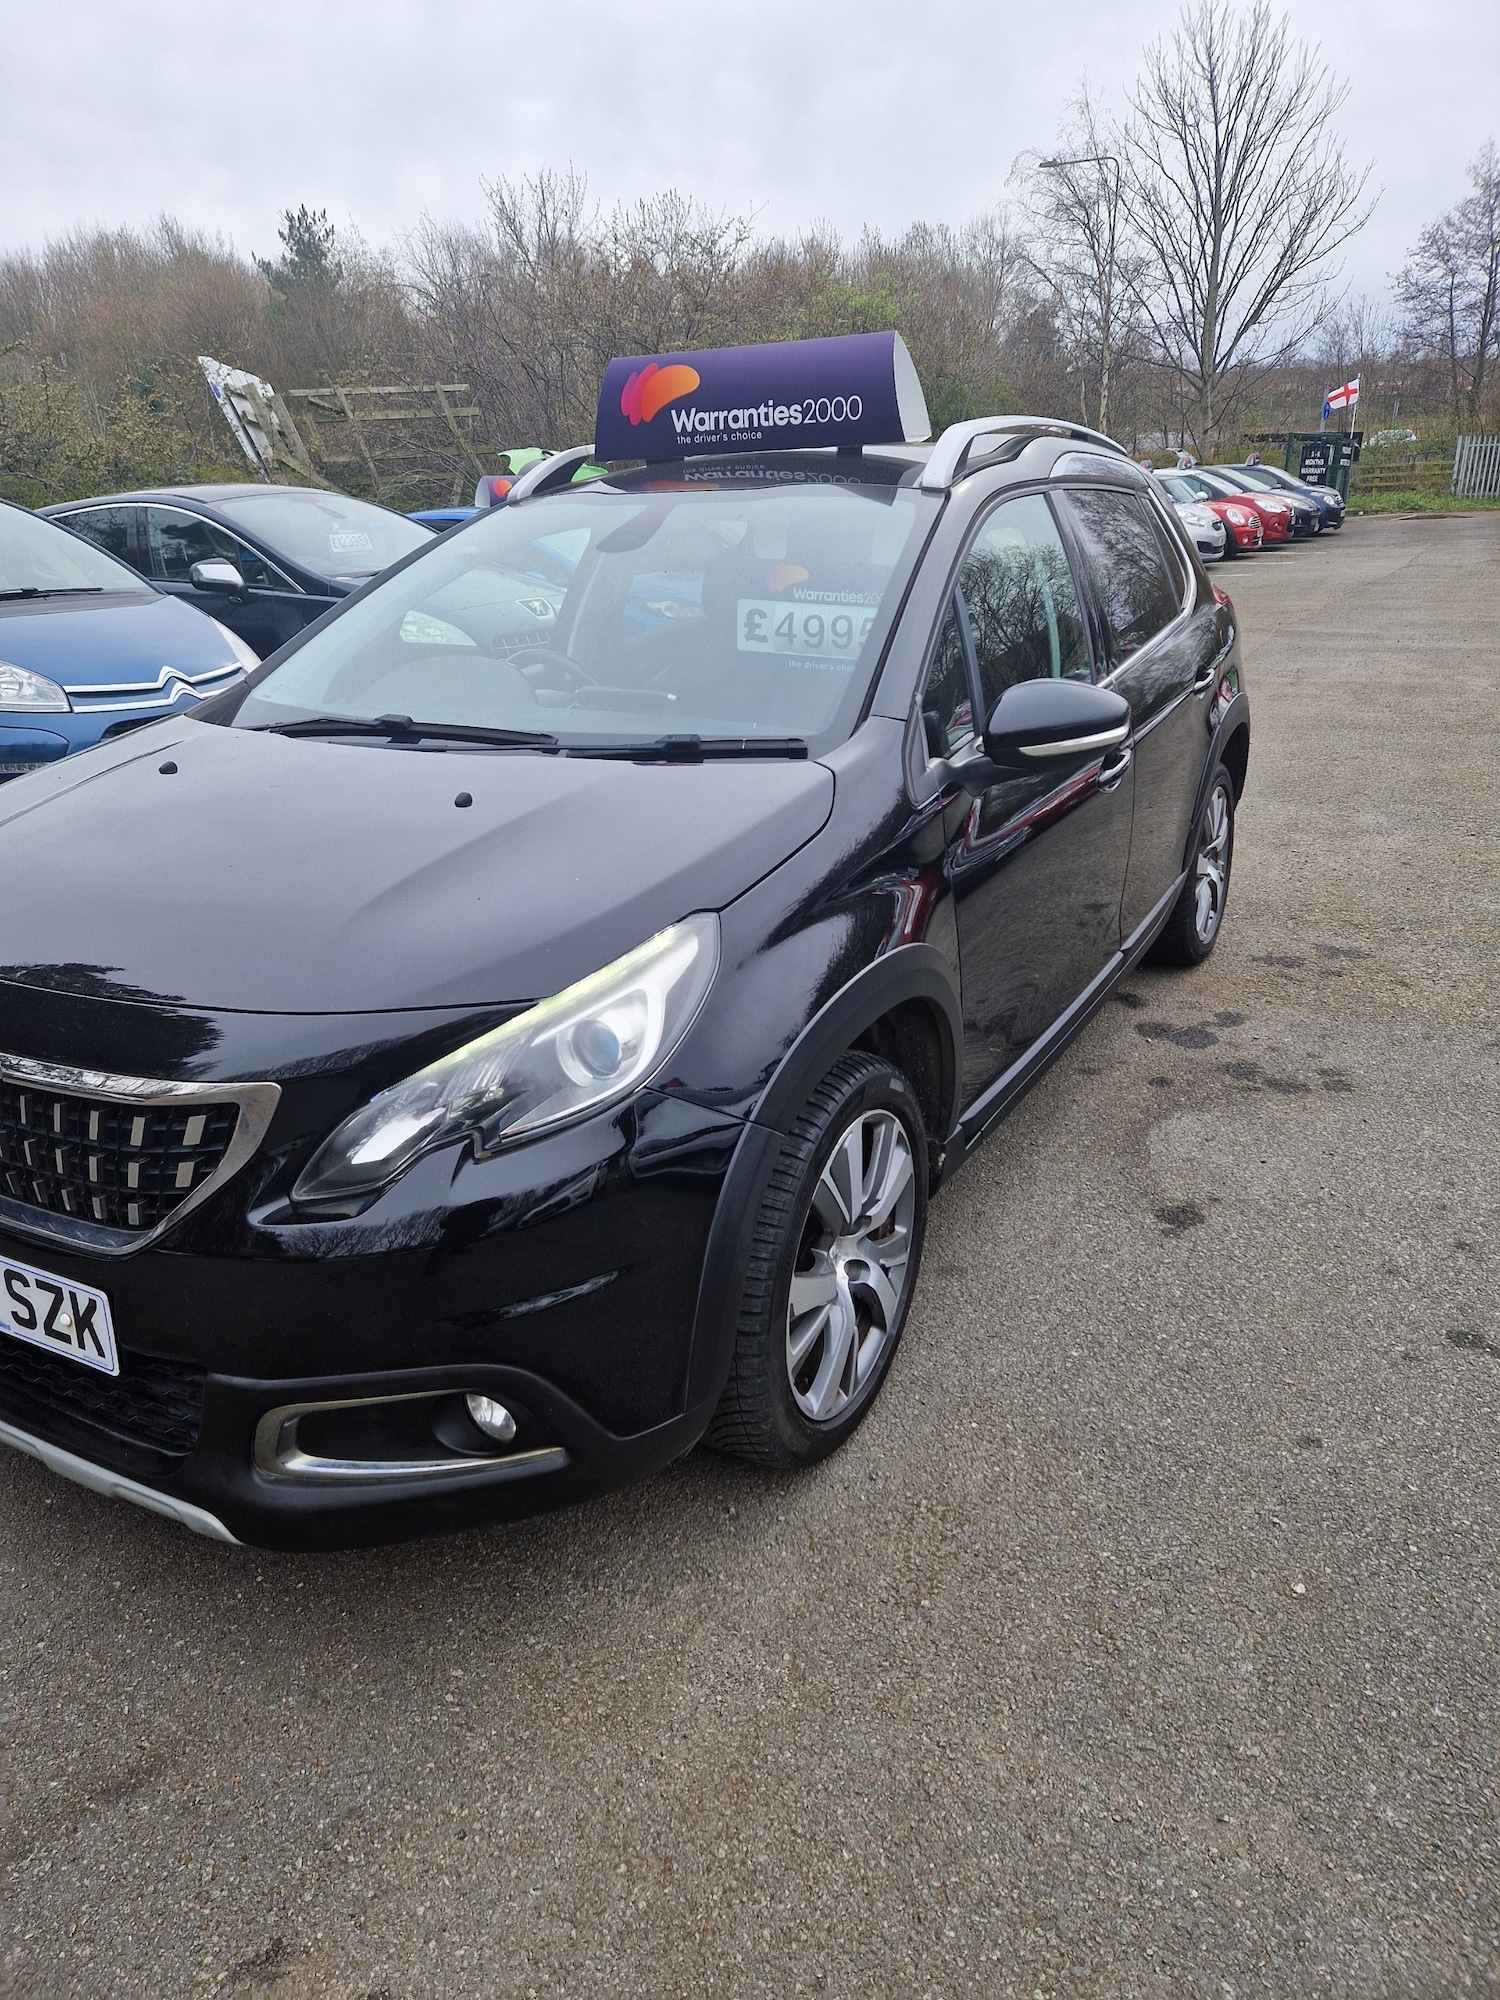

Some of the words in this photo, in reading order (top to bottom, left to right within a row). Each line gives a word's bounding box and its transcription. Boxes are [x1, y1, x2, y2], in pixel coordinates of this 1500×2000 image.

[670, 395, 863, 433] Warranties2000
[676, 434, 692, 445] the
[693, 432, 728, 443] driver's
[731, 431, 762, 441] choice
[1304, 458, 1325, 466] MONTHS
[1300, 467, 1327, 475] WARRANTY
[1306, 475, 1319, 483] FREE
[793, 586, 884, 604] Warranties20
[788, 660, 802, 668] the
[804, 661, 834, 671] driver's
[836, 664, 855, 673] choi
[3, 1268, 106, 1359] SZK
